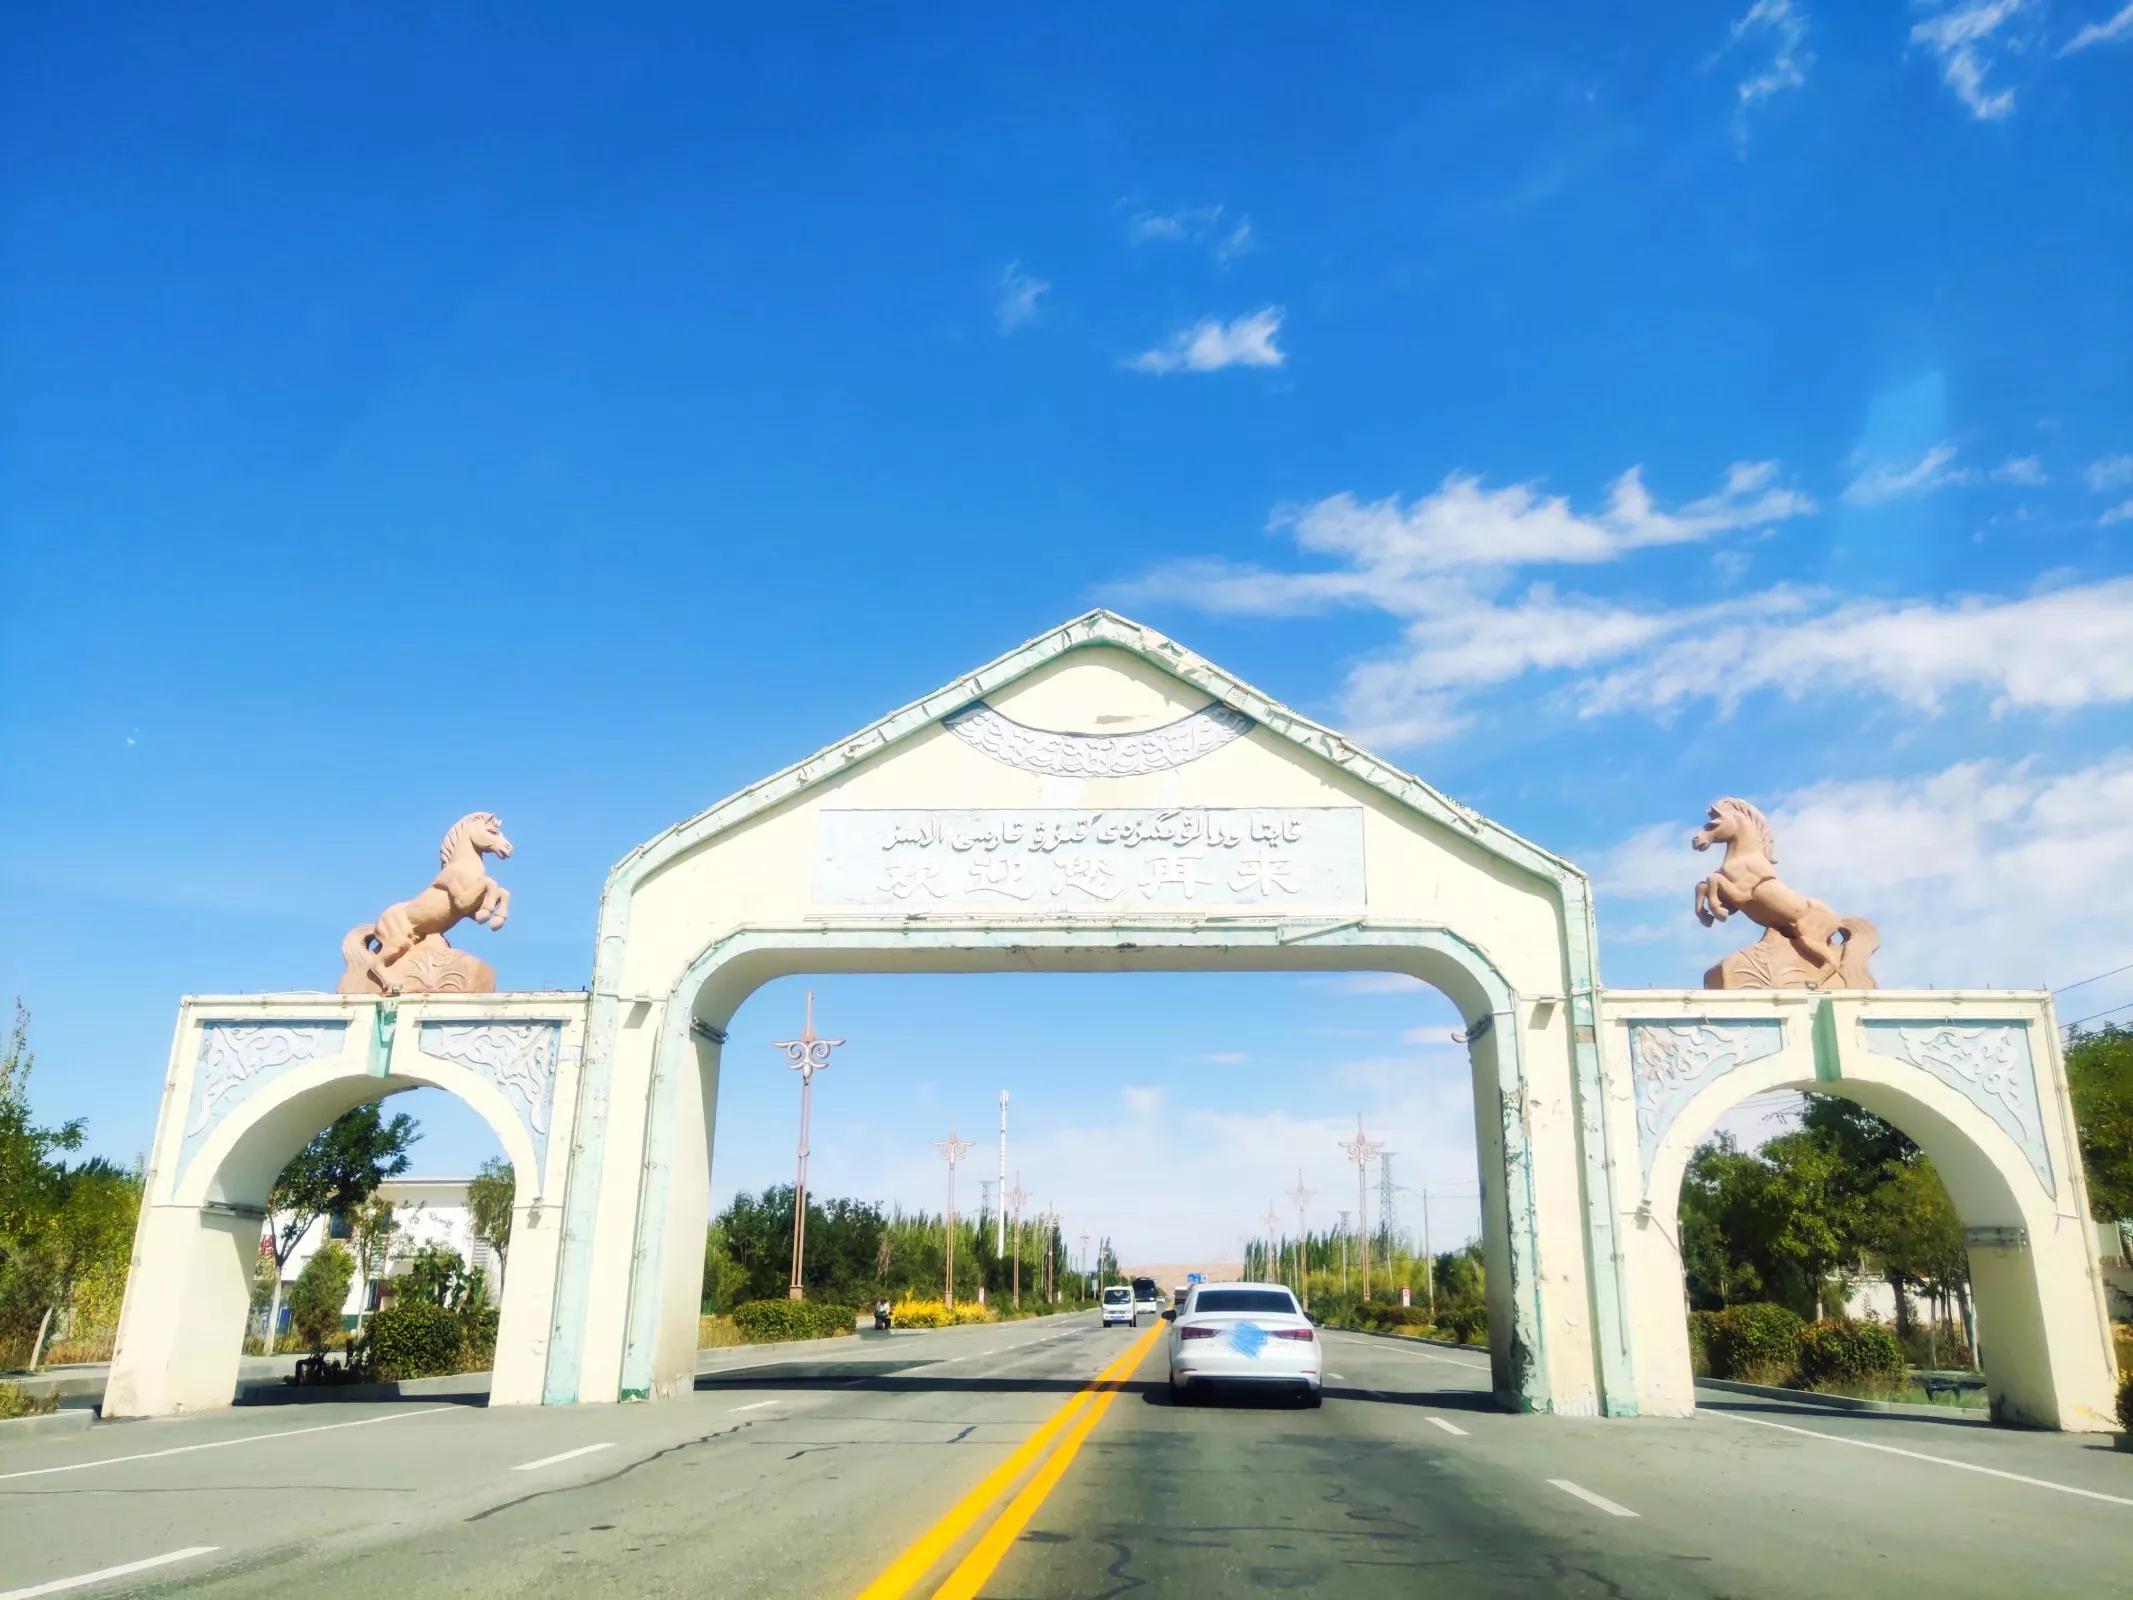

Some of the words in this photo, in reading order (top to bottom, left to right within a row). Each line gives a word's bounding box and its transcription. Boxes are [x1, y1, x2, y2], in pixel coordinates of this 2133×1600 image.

[876, 850, 1303, 901] 欢迎您再来
